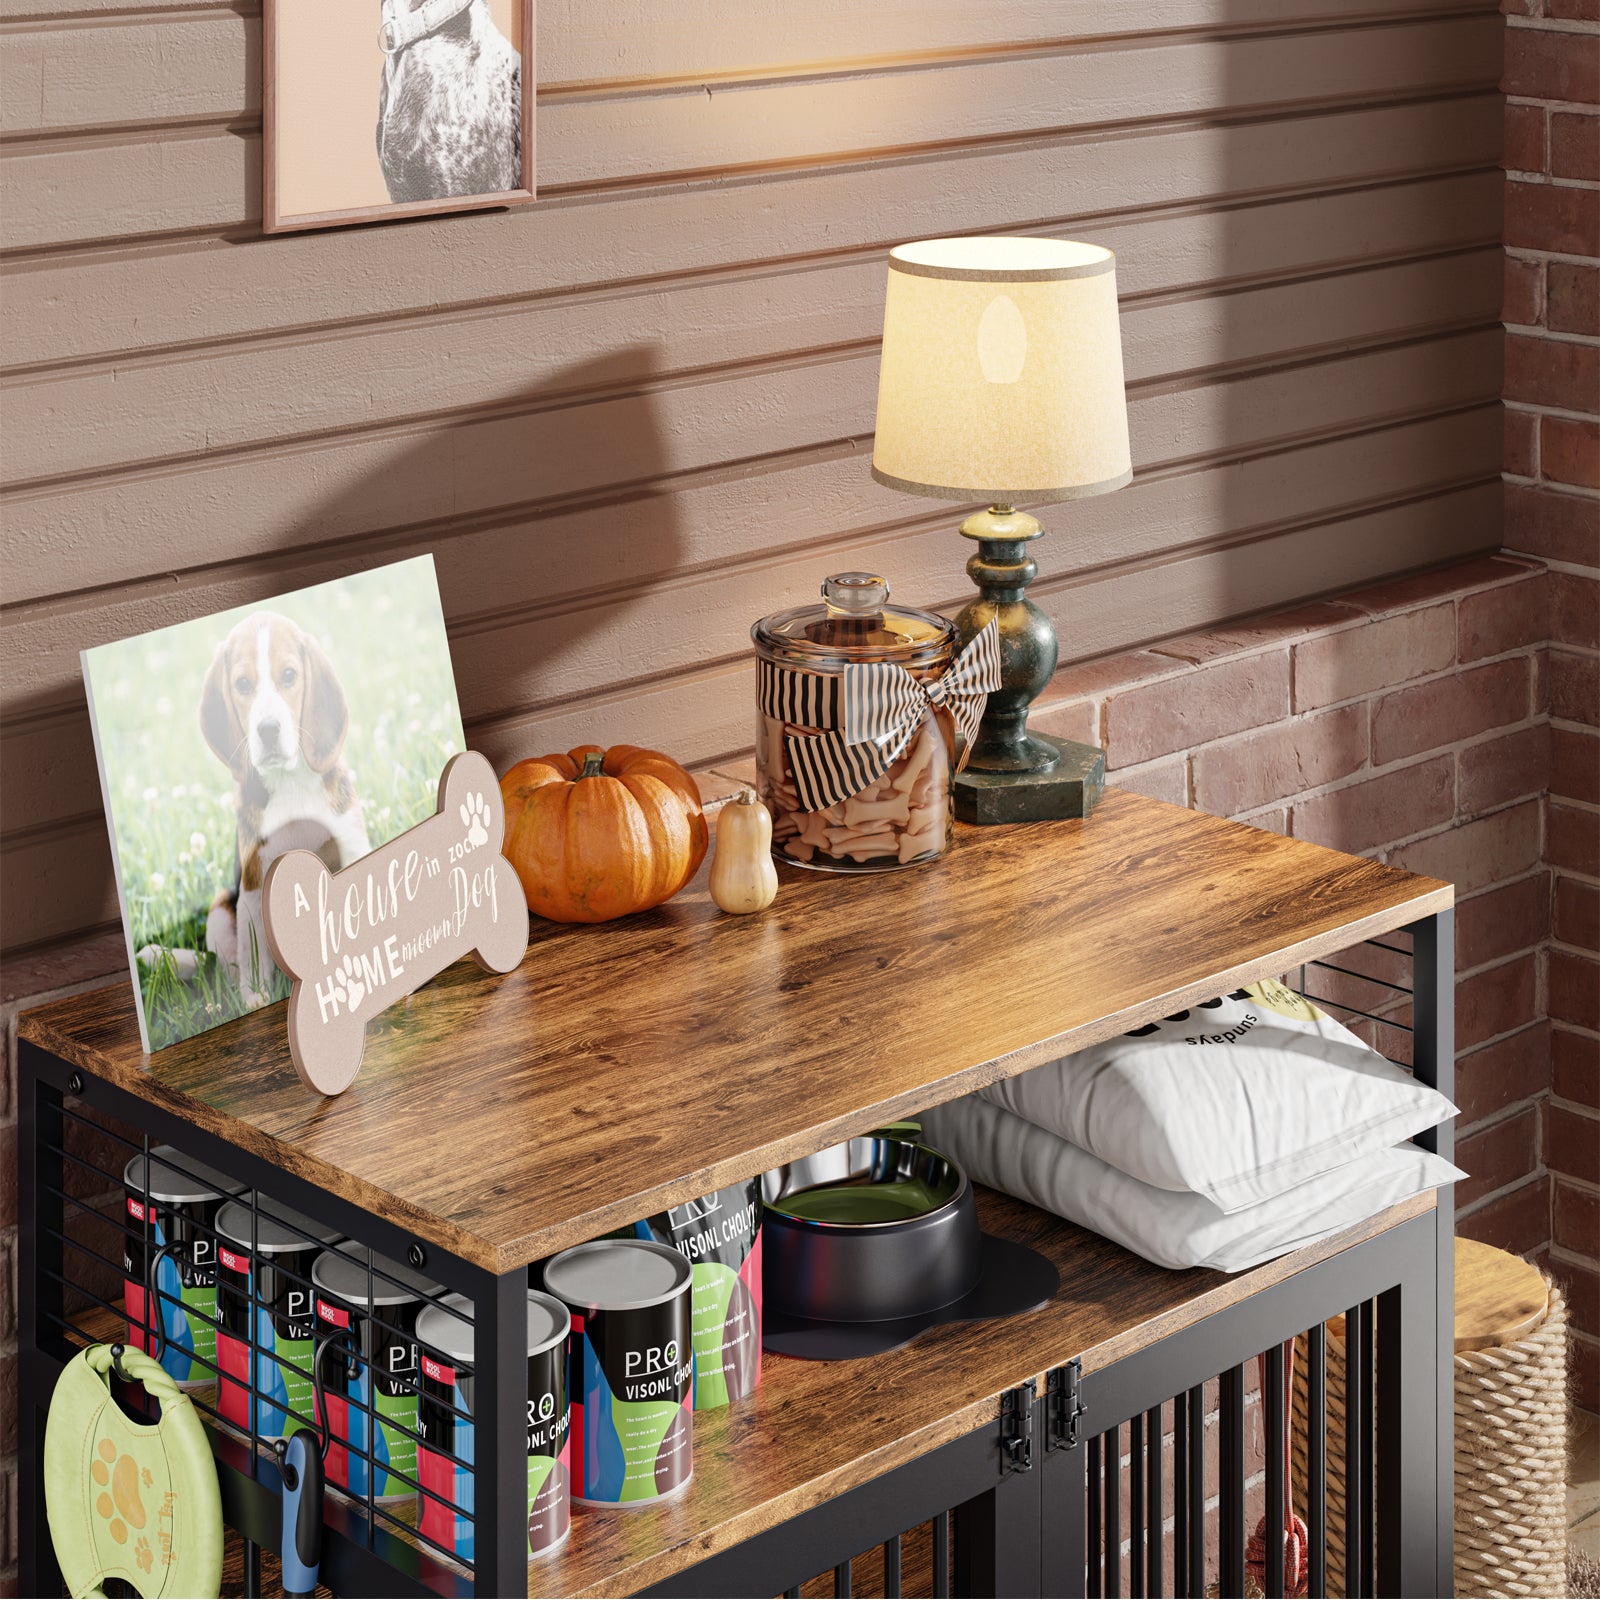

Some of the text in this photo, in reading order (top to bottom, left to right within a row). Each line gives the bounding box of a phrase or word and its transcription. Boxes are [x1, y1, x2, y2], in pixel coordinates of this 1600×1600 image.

[293, 882, 311, 918] A
[318, 850, 426, 965] house
[425, 856, 441, 879] in
[448, 864, 498, 937] Dog
[1185, 1013, 1257, 1046] sundays
[676, 1227, 722, 1260] VISONL
[625, 1340, 678, 1376] PRO
[625, 1357, 693, 1400] VISONL CHOL
